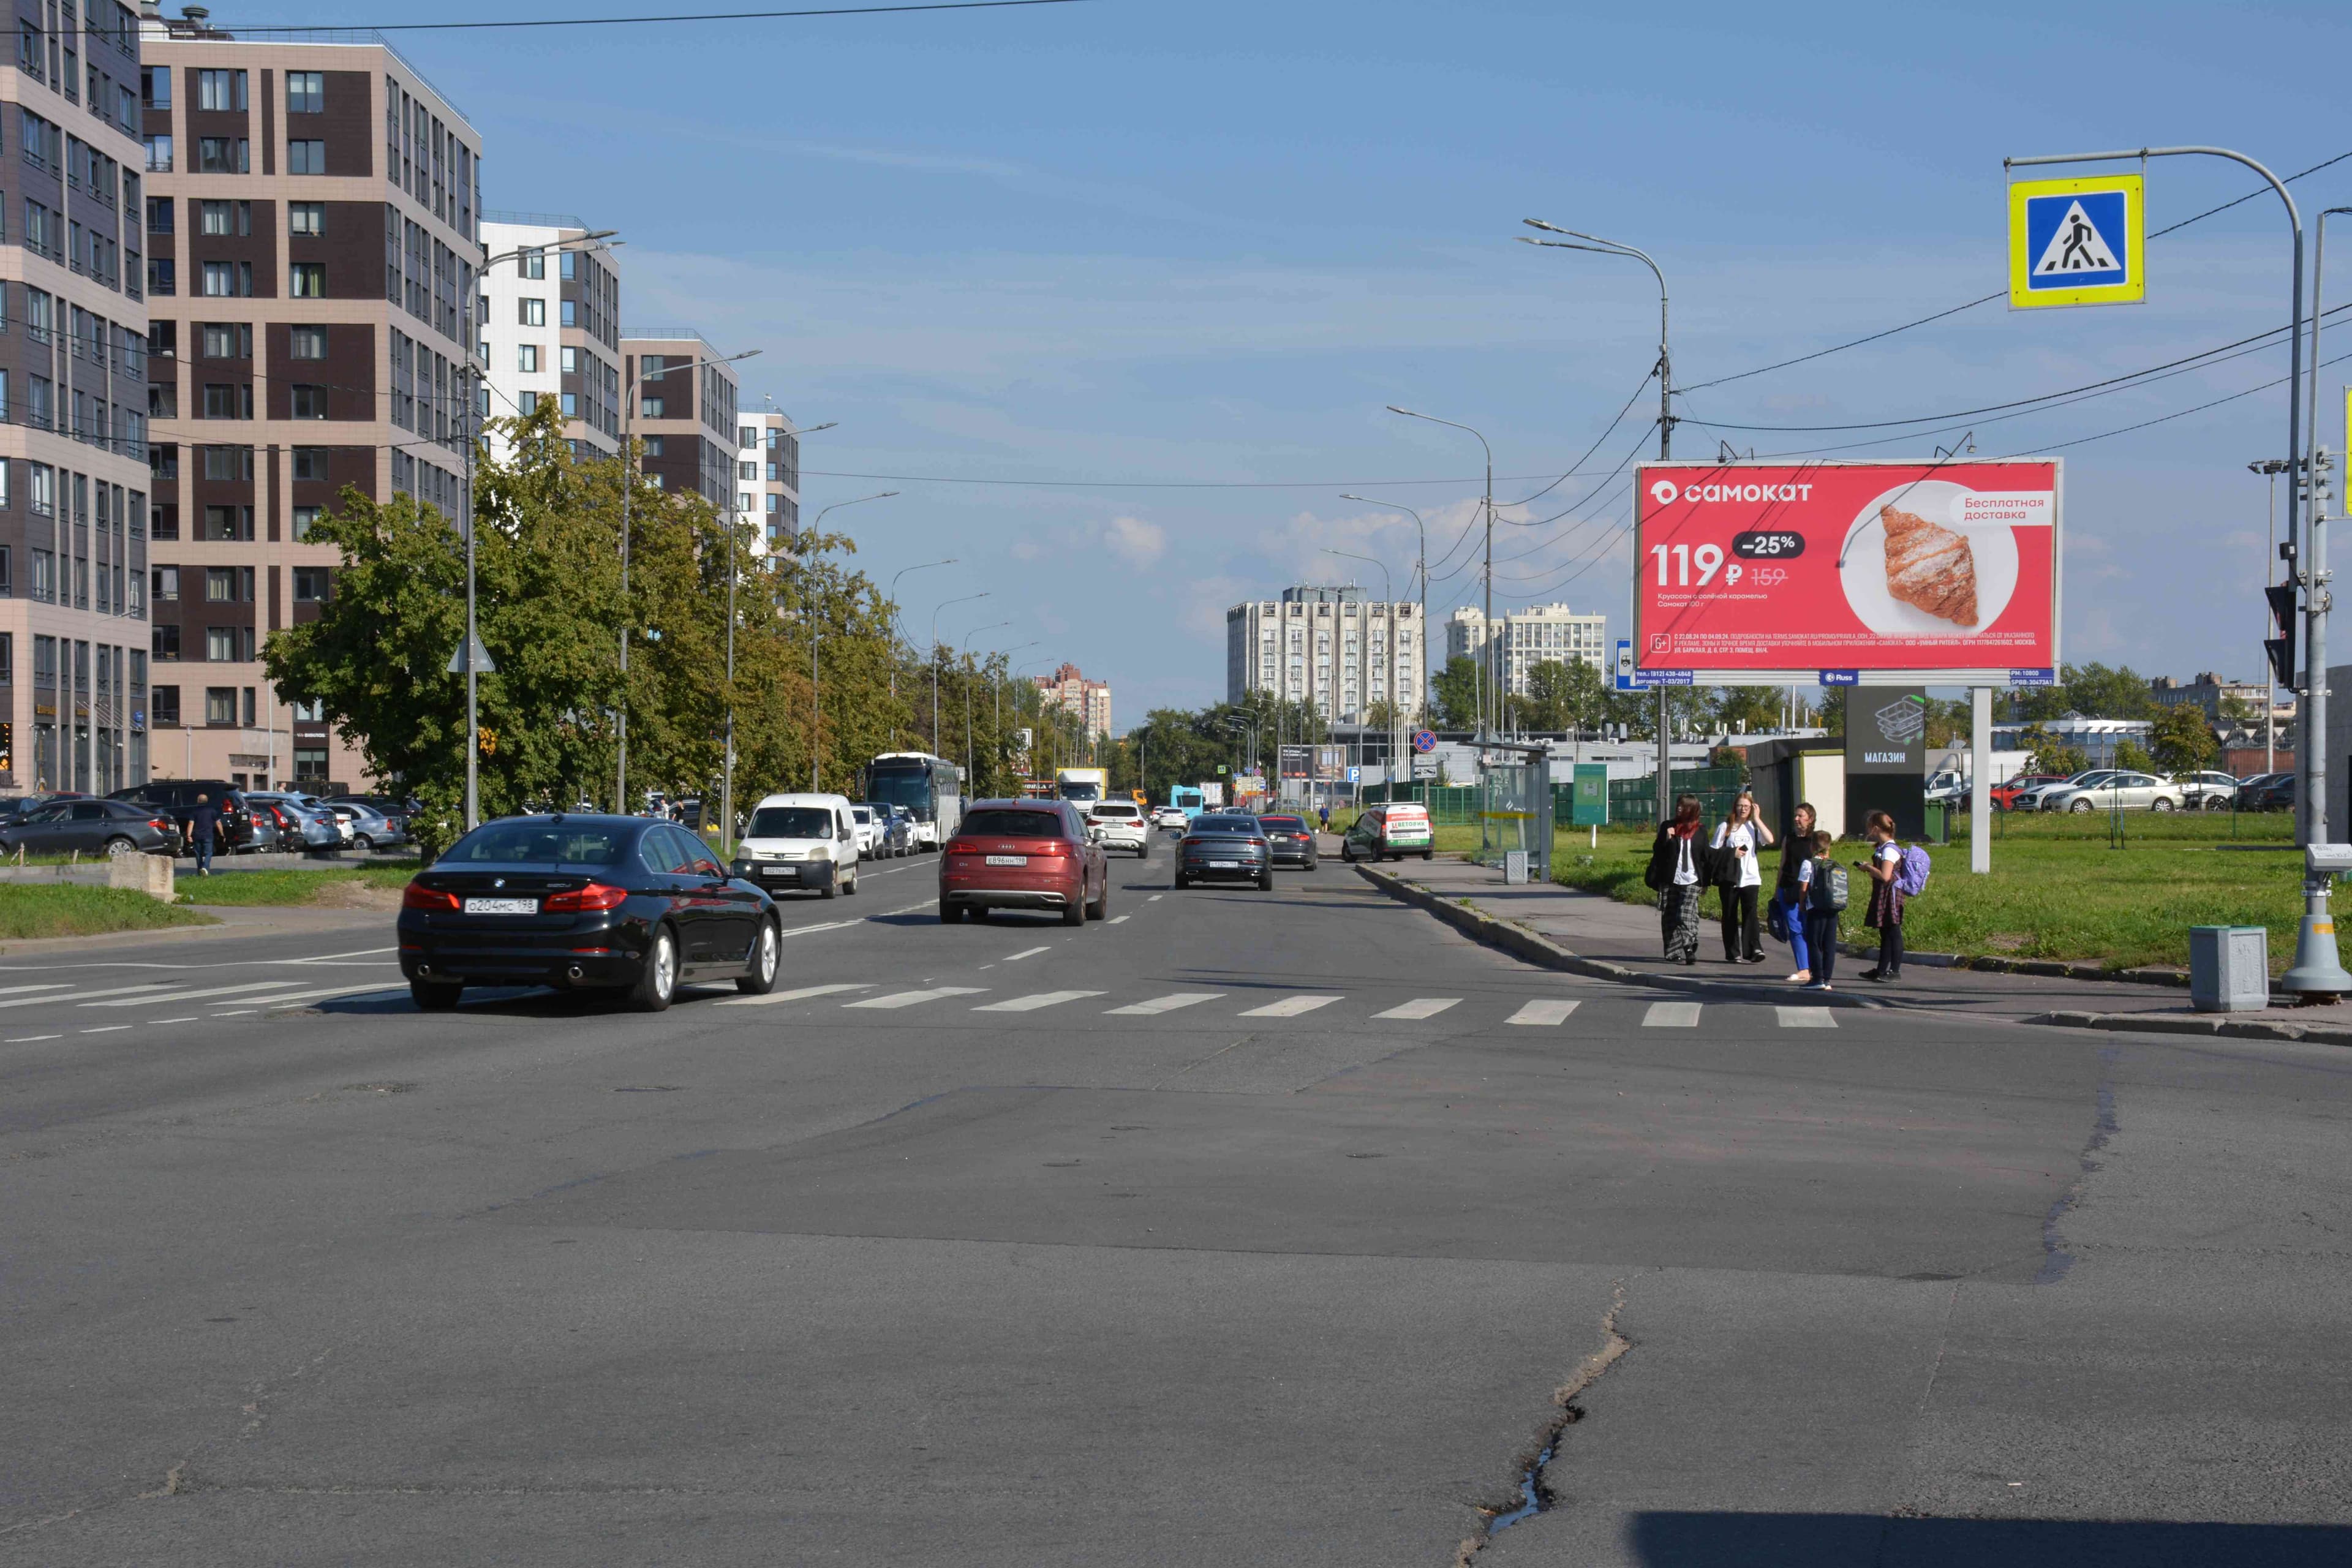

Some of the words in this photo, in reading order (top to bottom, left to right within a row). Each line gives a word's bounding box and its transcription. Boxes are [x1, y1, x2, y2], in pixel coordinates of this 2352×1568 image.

[1684, 484, 1813, 503] самокат
[1965, 498, 2045, 508] Бесплатная
[1964, 511, 2026, 521] доставка
[1655, 637, 1667, 650] 6+
[1864, 752, 1906, 763] МАГАЗИН
[1832, 870, 1848, 905] PLAY
[469, 900, 514, 911] О204МС
[516, 899, 534, 909] 198
